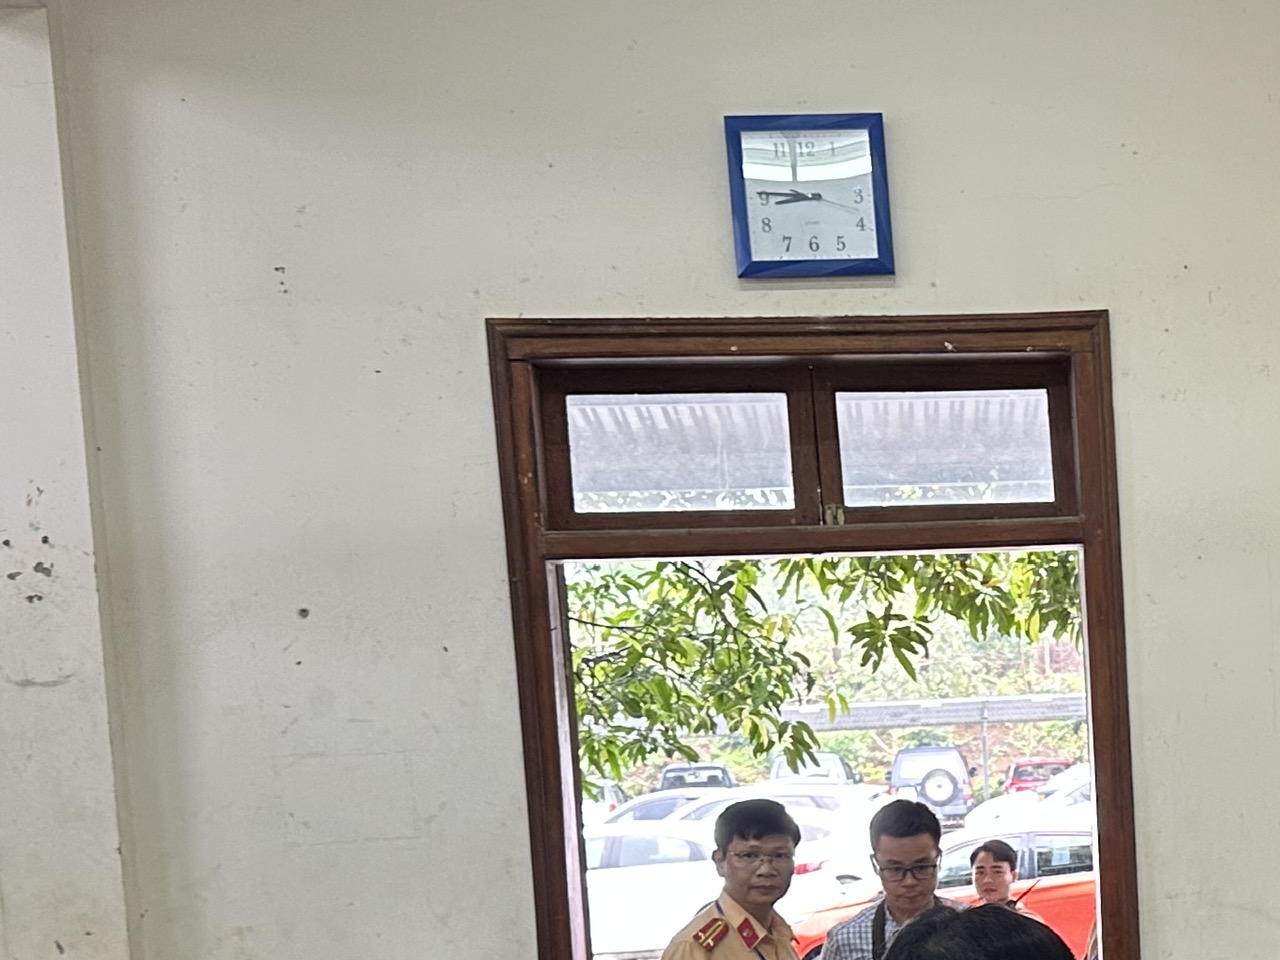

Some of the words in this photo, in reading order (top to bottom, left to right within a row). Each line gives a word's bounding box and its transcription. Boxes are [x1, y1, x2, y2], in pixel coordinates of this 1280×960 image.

[797, 141, 815, 157] 12
[854, 189, 863, 204] 3
[762, 218, 772, 233] 8
[856, 217, 866, 231] 4
[783, 236, 792, 252] 7
[809, 236, 820, 252] 6
[837, 236, 846, 252] 5
